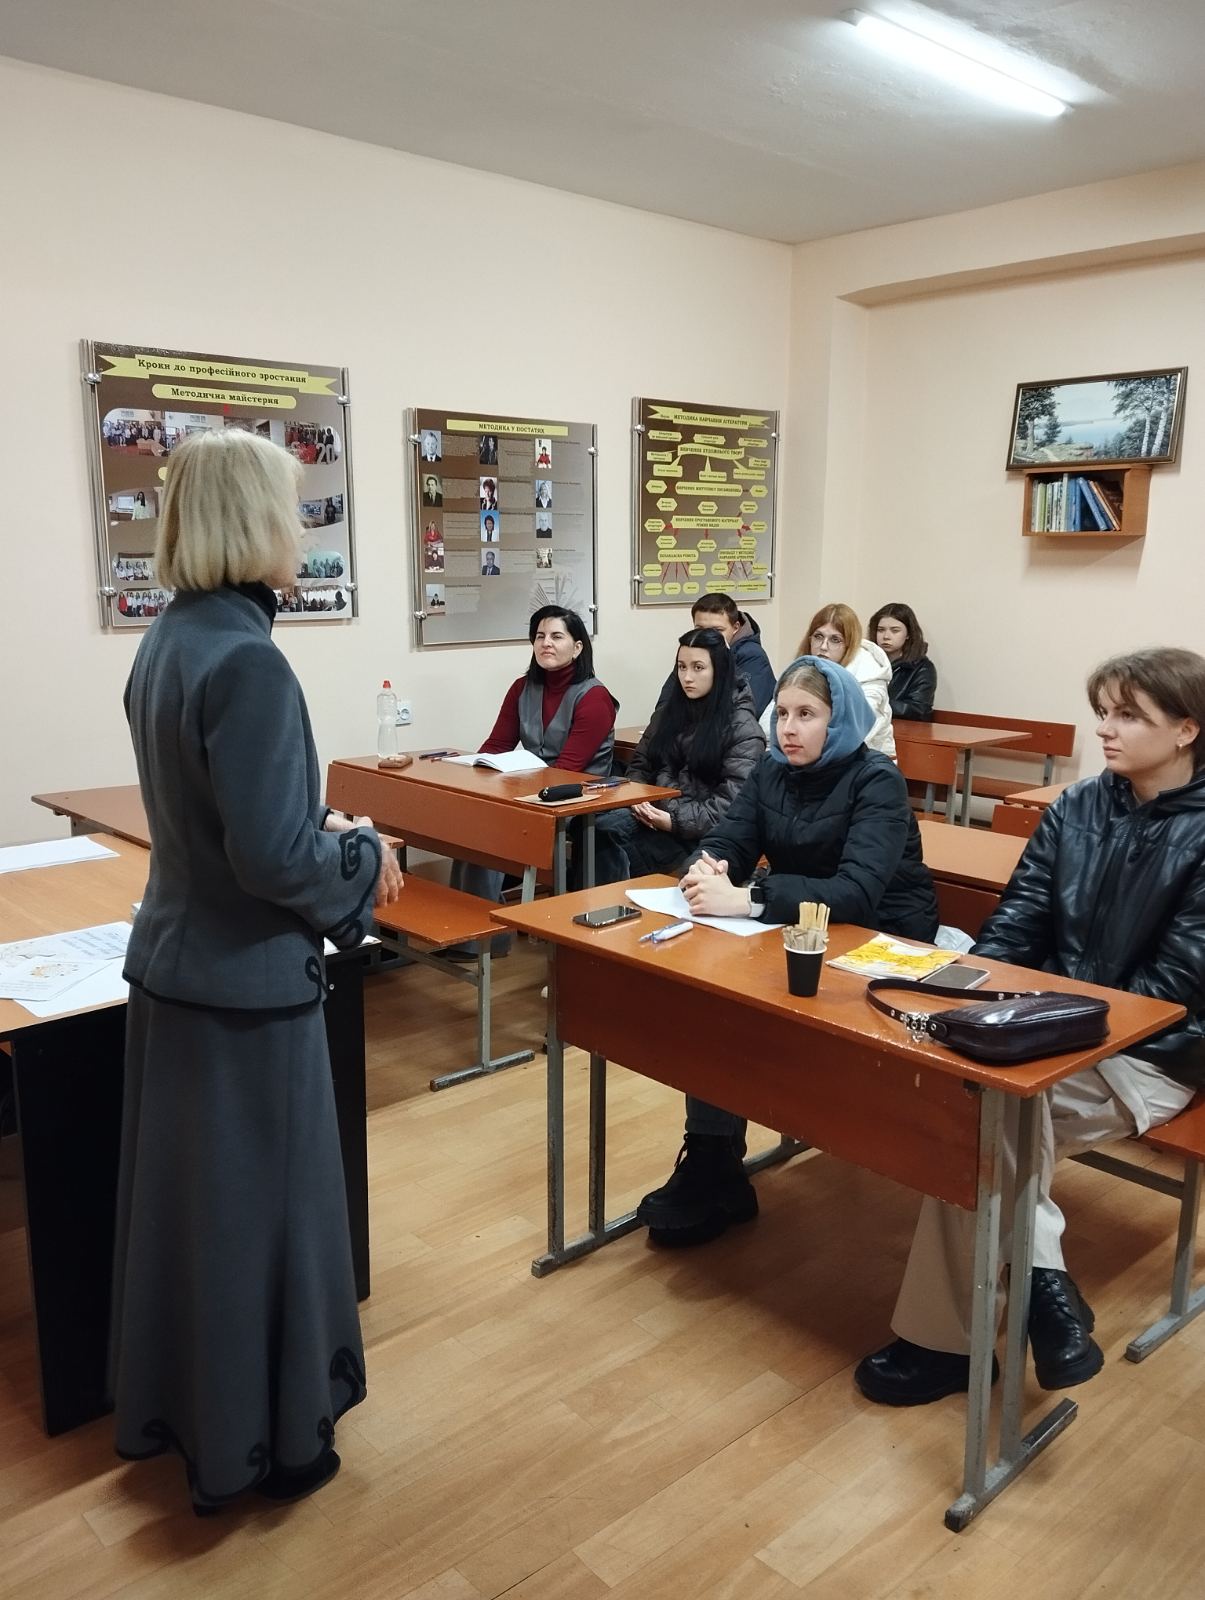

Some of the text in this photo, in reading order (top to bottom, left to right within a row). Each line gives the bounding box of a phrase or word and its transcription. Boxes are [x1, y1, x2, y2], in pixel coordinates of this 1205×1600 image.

[138, 359, 307, 384] Кроки до професійного зростання
[171, 388, 279, 406] Методична майстерня
[516, 426, 545, 434] ПОСТАТЯХ
